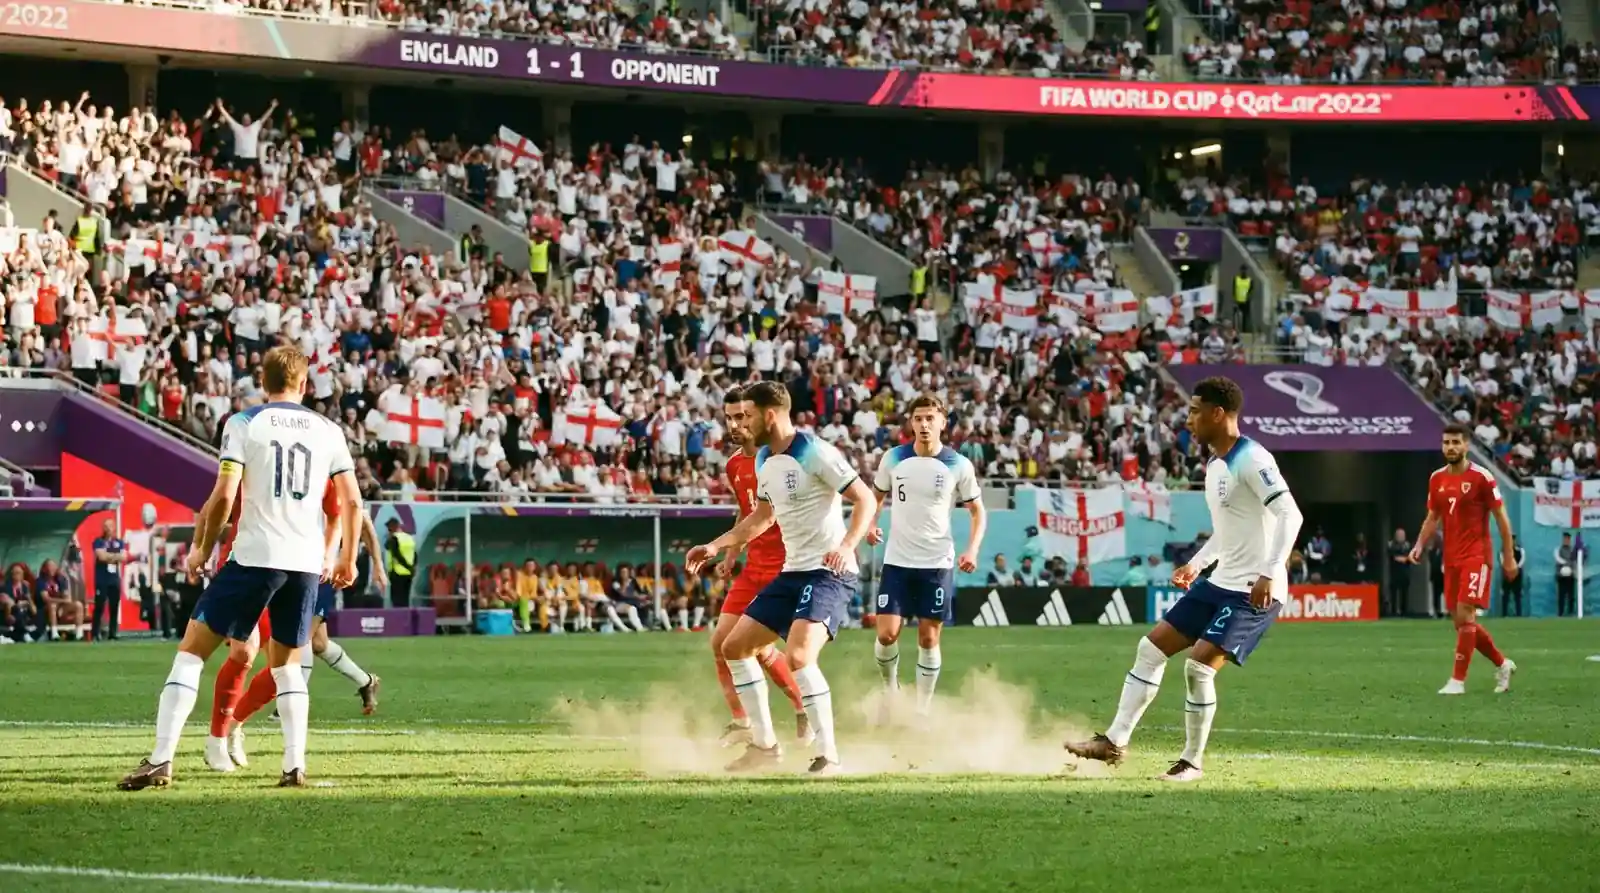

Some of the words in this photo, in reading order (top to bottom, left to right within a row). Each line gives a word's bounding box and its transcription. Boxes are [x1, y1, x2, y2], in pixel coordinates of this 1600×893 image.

[400, 39, 499, 68] ENGLAND
[526, 47, 541, 74] 1
[569, 51, 585, 78] 1
[611, 58, 720, 87] OPPONENT
[1040, 86, 1087, 107] FIFA
[1088, 88, 1170, 110] WORLD
[1172, 90, 1217, 111] CUP
[1242, 416, 1290, 426] FIFA
[1289, 416, 1369, 426] WORLD
[1371, 416, 1413, 425] CUP
[270, 439, 312, 501] 10
[898, 484, 906, 502] 6
[1448, 496, 1456, 515] 7
[1047, 513, 1118, 536] ENGLAND
[1469, 572, 1479, 590] 2
[800, 584, 813, 604] 8
[935, 587, 944, 606] 9
[1303, 592, 1362, 618] Deliver
[1214, 606, 1233, 628] 2
